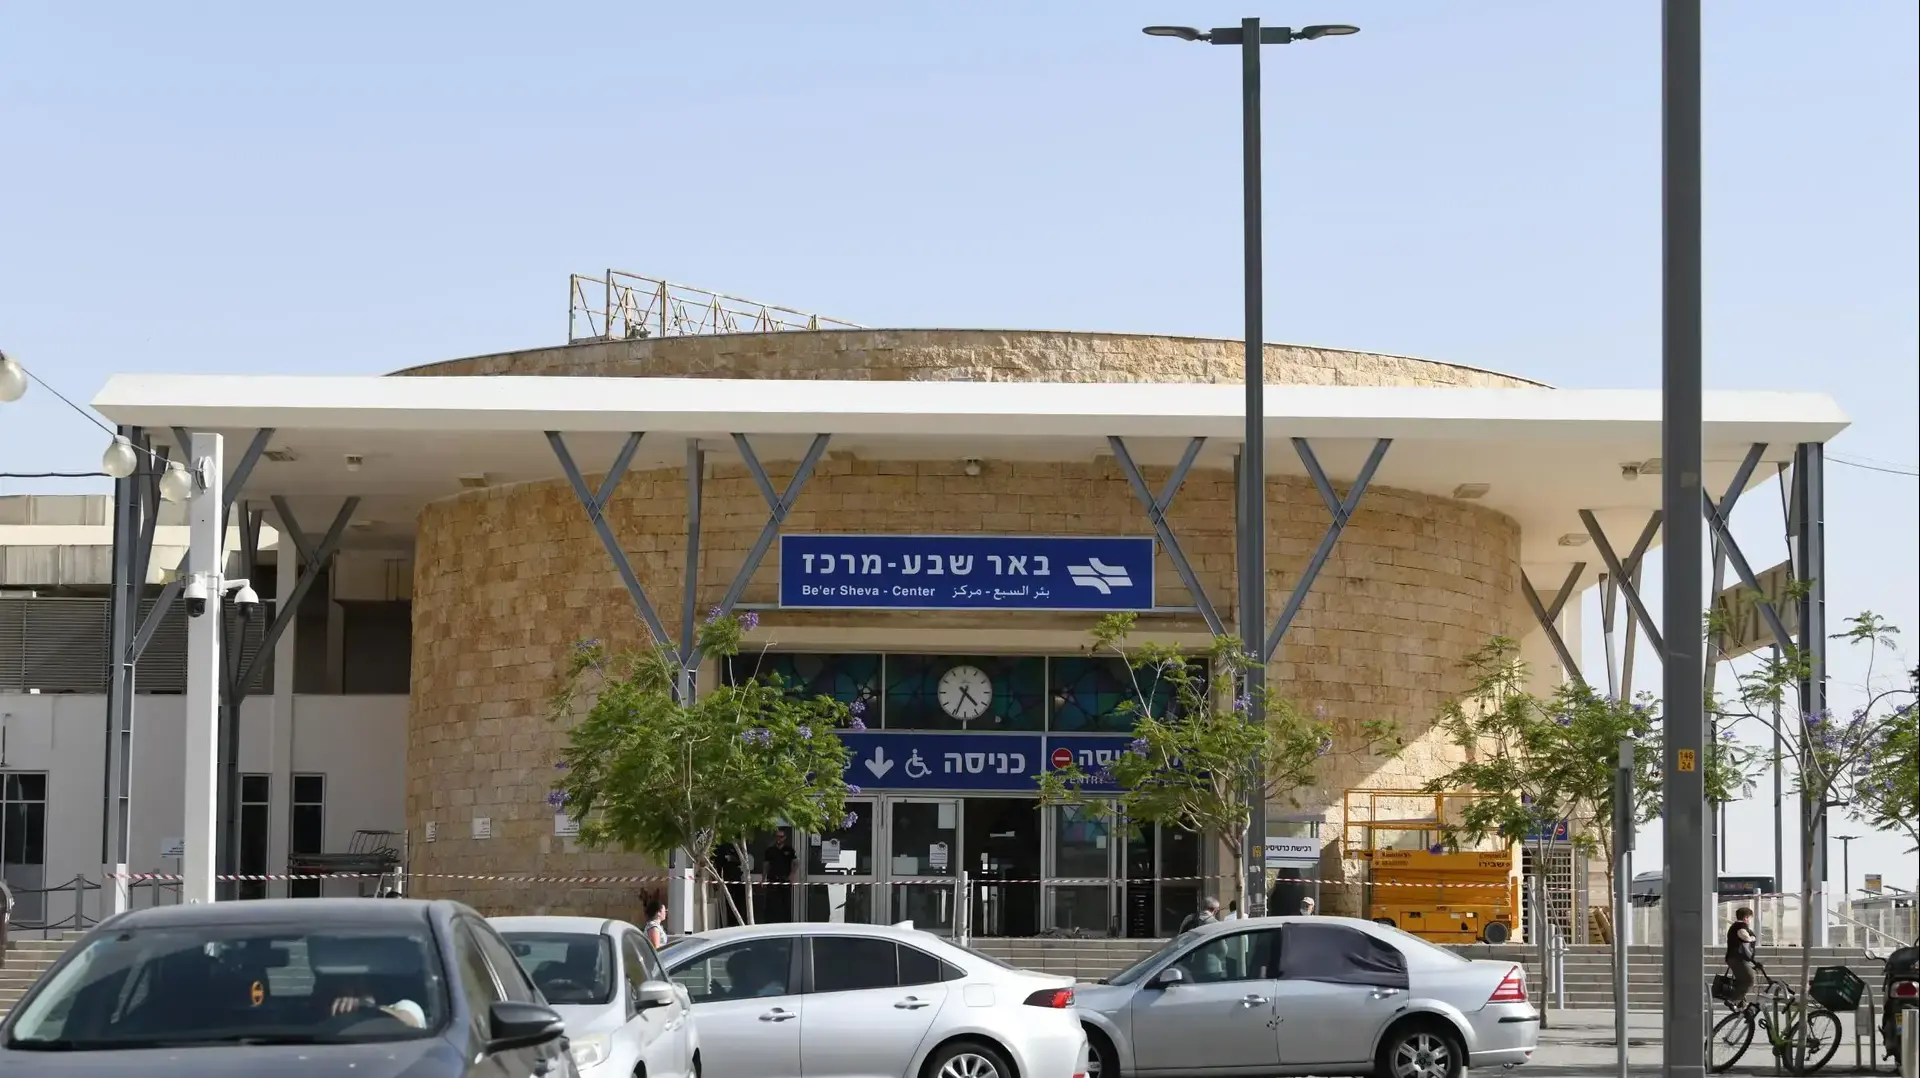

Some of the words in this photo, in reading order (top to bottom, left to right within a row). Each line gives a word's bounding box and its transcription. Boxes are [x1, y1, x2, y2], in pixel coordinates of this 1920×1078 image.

[802, 553, 974, 576] שבע-מרכז
[987, 555, 1050, 576] באר
[802, 585, 836, 596] Be'er
[840, 585, 880, 596] Sheva
[892, 585, 936, 597] Center
[952, 584, 982, 599] مركز
[993, 585, 1029, 600] السبع
[1033, 586, 1050, 599] بئر
[944, 752, 1026, 774] כניסה
[1290, 845, 1312, 853] רכישת
